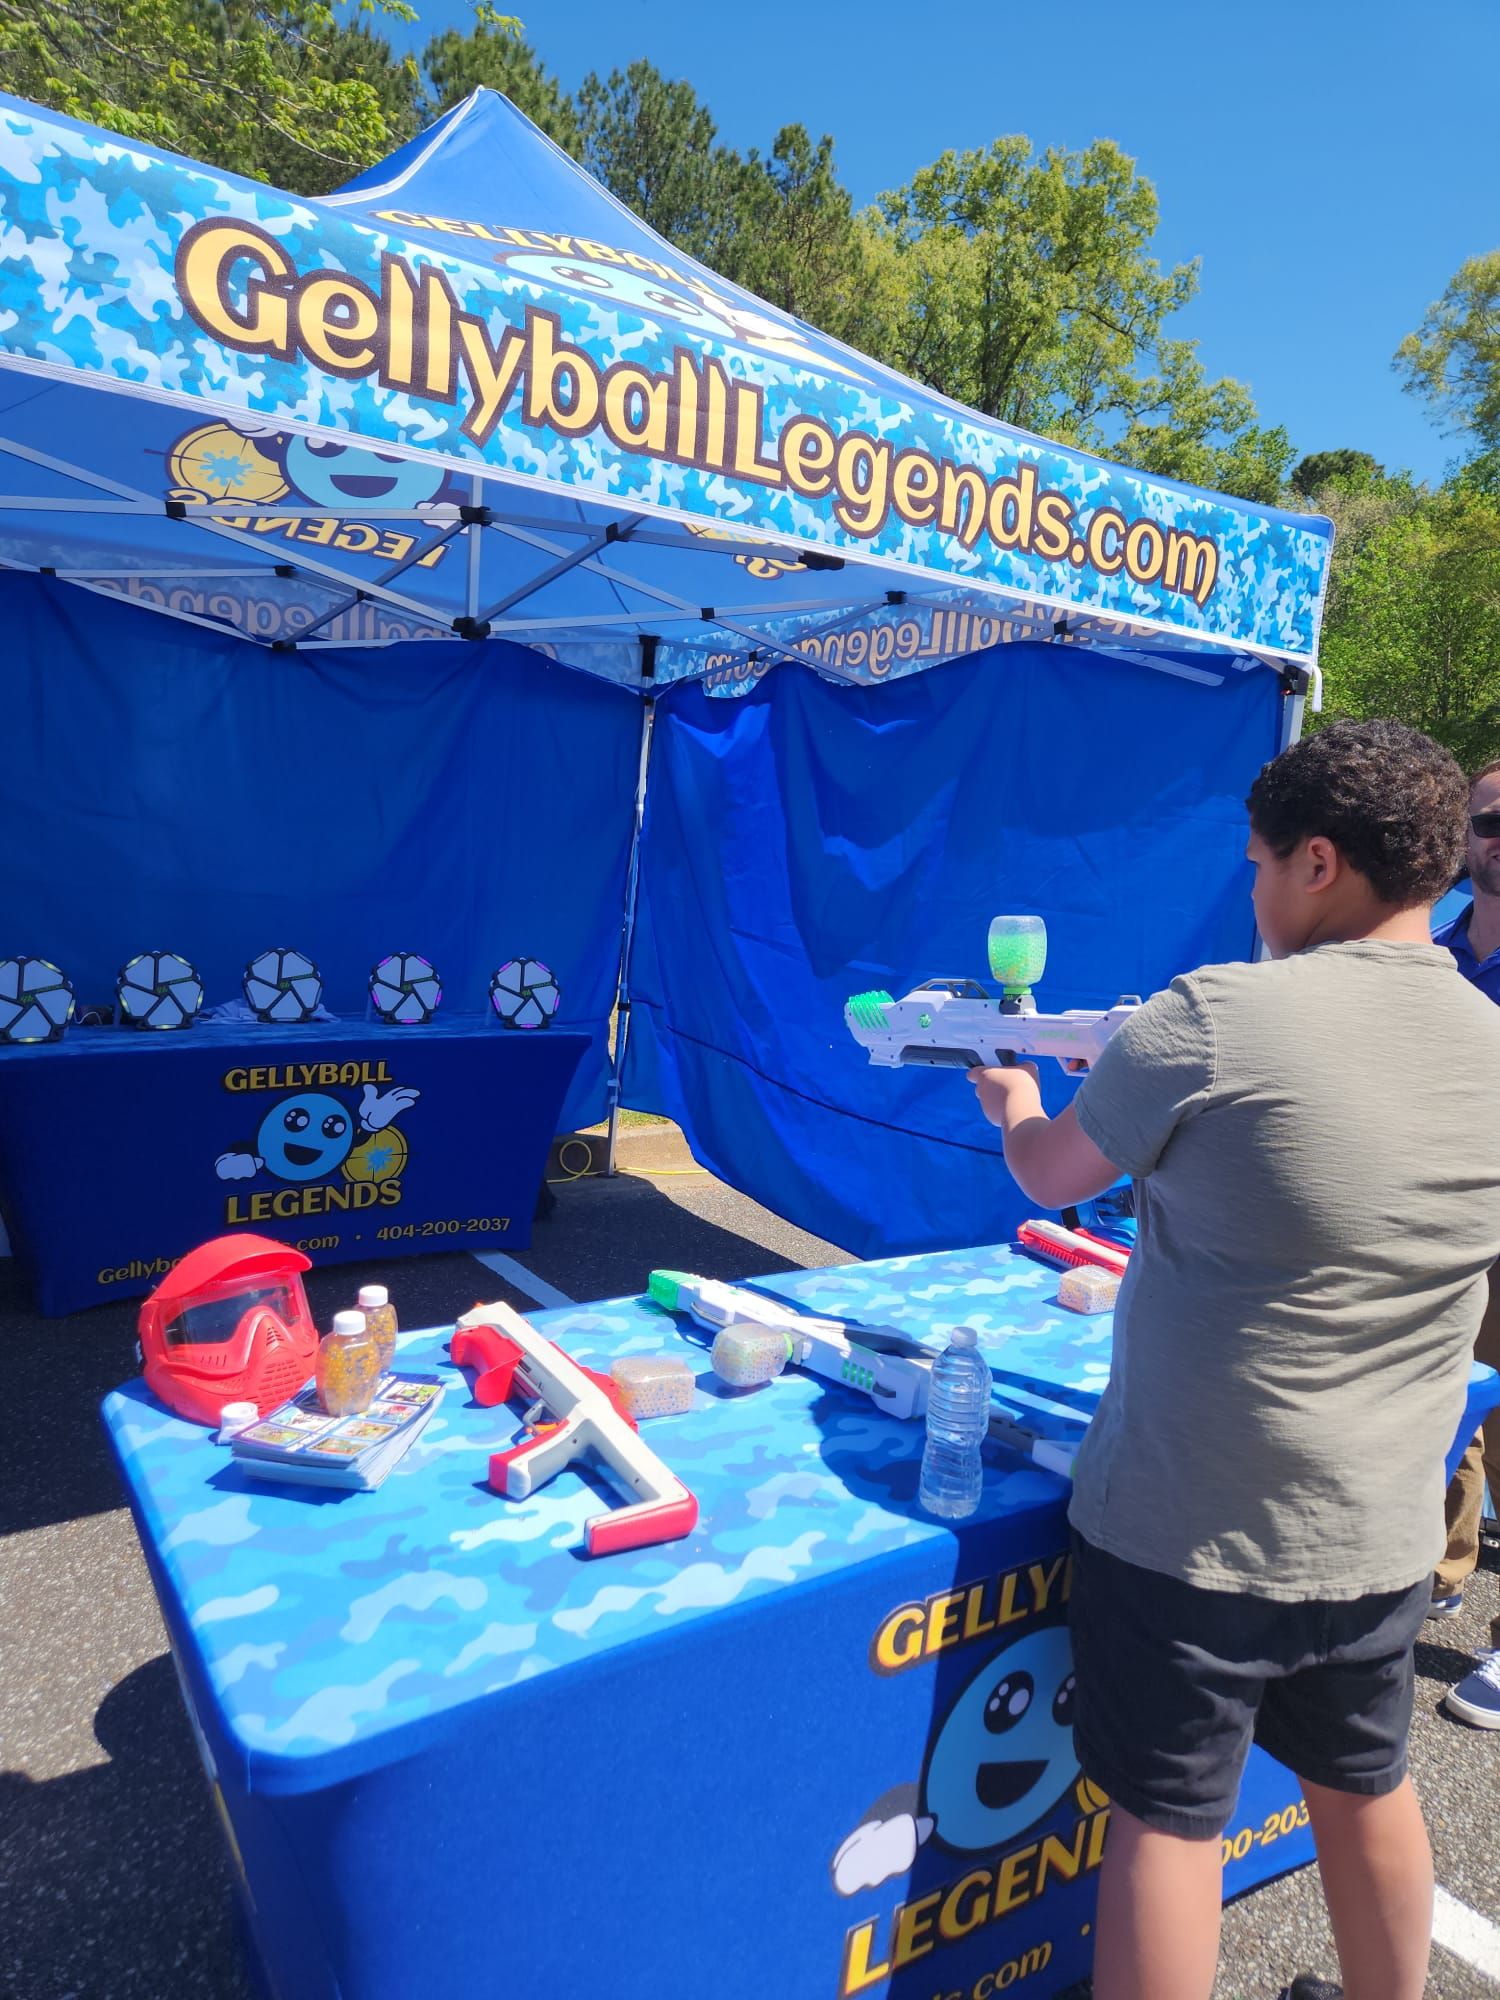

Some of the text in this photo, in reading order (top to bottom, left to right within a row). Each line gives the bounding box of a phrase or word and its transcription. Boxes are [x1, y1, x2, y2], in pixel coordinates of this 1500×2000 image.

[177, 217, 1220, 604] GellyballLegends.com
[224, 1059, 393, 1092] GELLYBALL
[226, 1179, 402, 1225] LEGENDS
[376, 1217, 511, 1242] 404-200-2037
